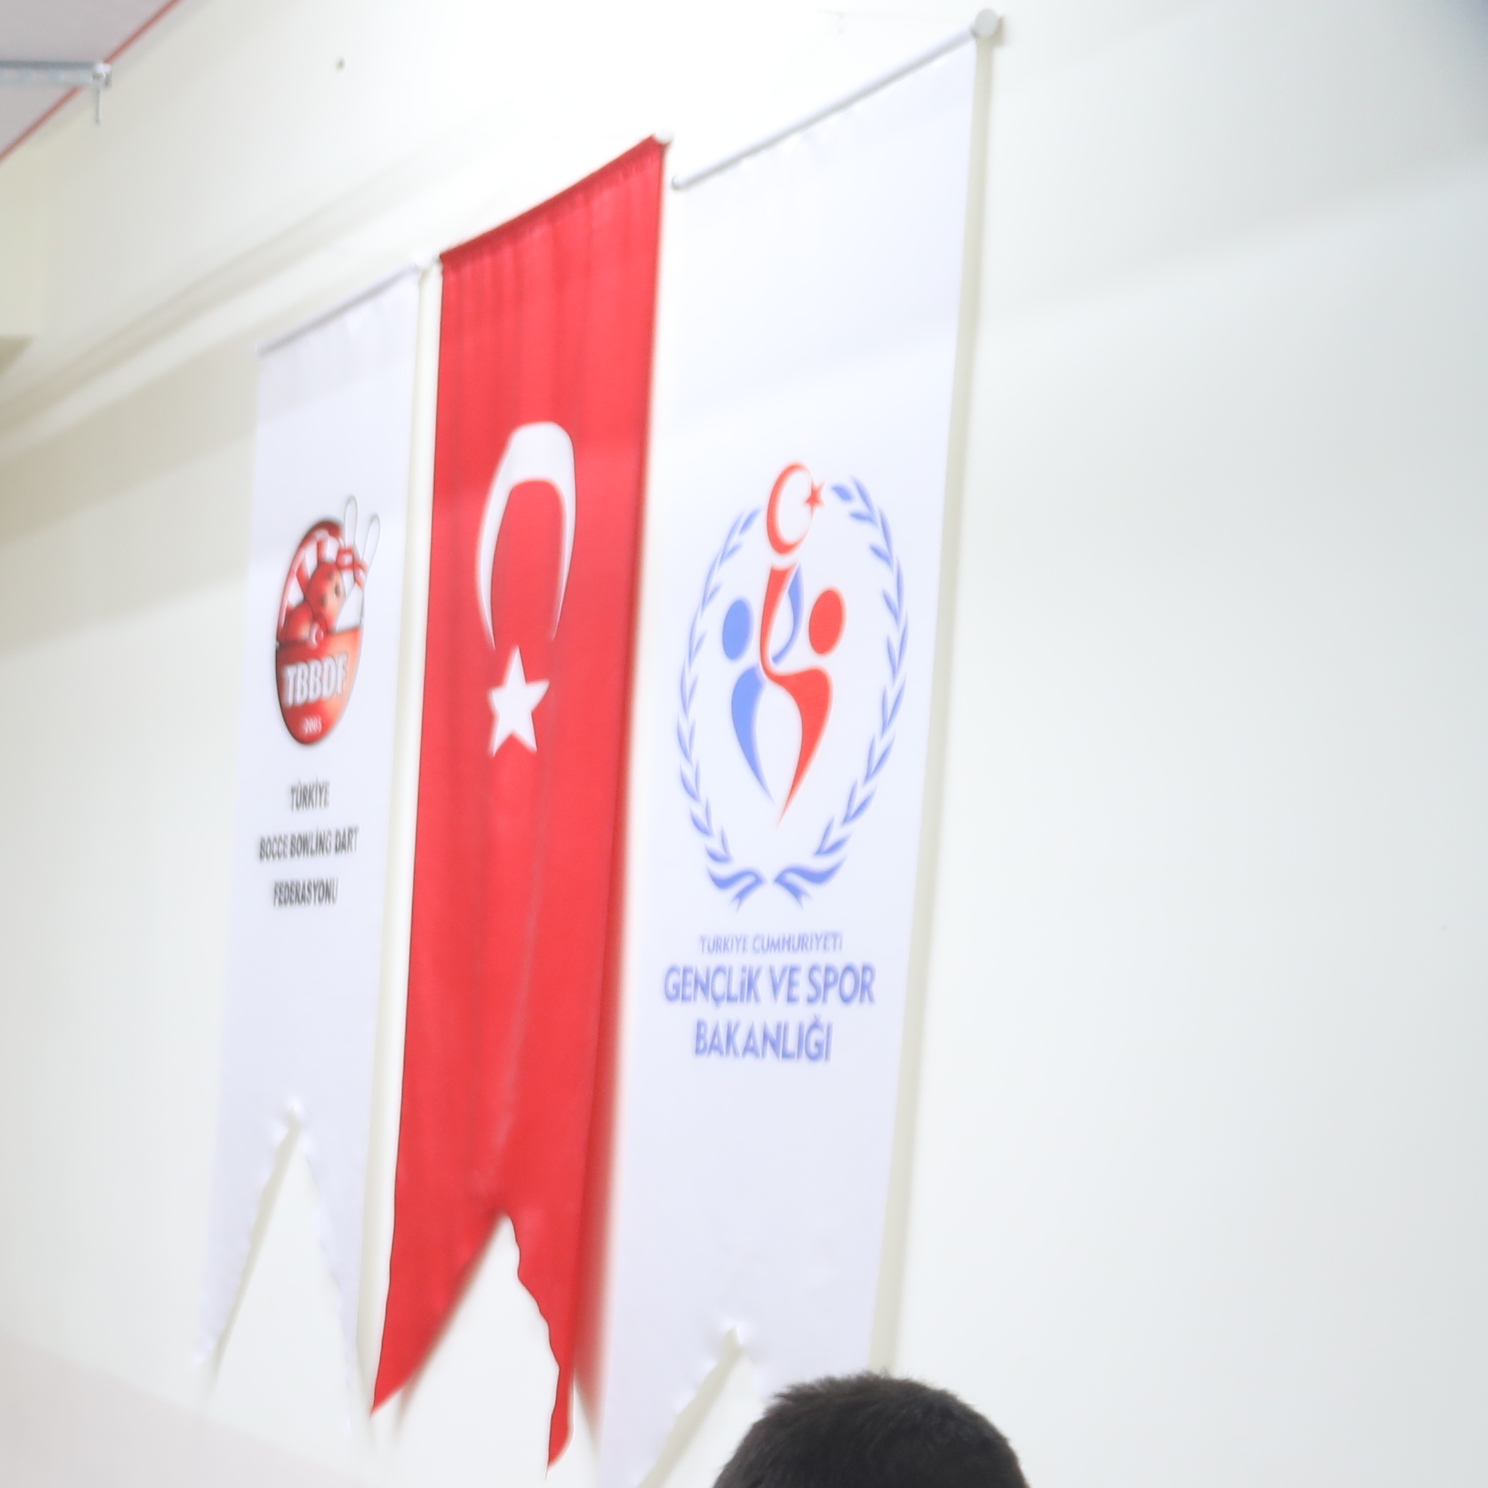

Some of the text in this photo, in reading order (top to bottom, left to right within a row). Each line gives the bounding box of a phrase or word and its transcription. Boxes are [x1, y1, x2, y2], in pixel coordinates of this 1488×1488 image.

[284, 652, 348, 707] TBBDF
[259, 834, 288, 861] BOCCE
[334, 825, 359, 855] DART
[273, 877, 339, 907] FEDERASYONU
[664, 963, 875, 1008] GENÇLİK VE SPOR
[695, 1014, 833, 1061] BAKANLIĞI
